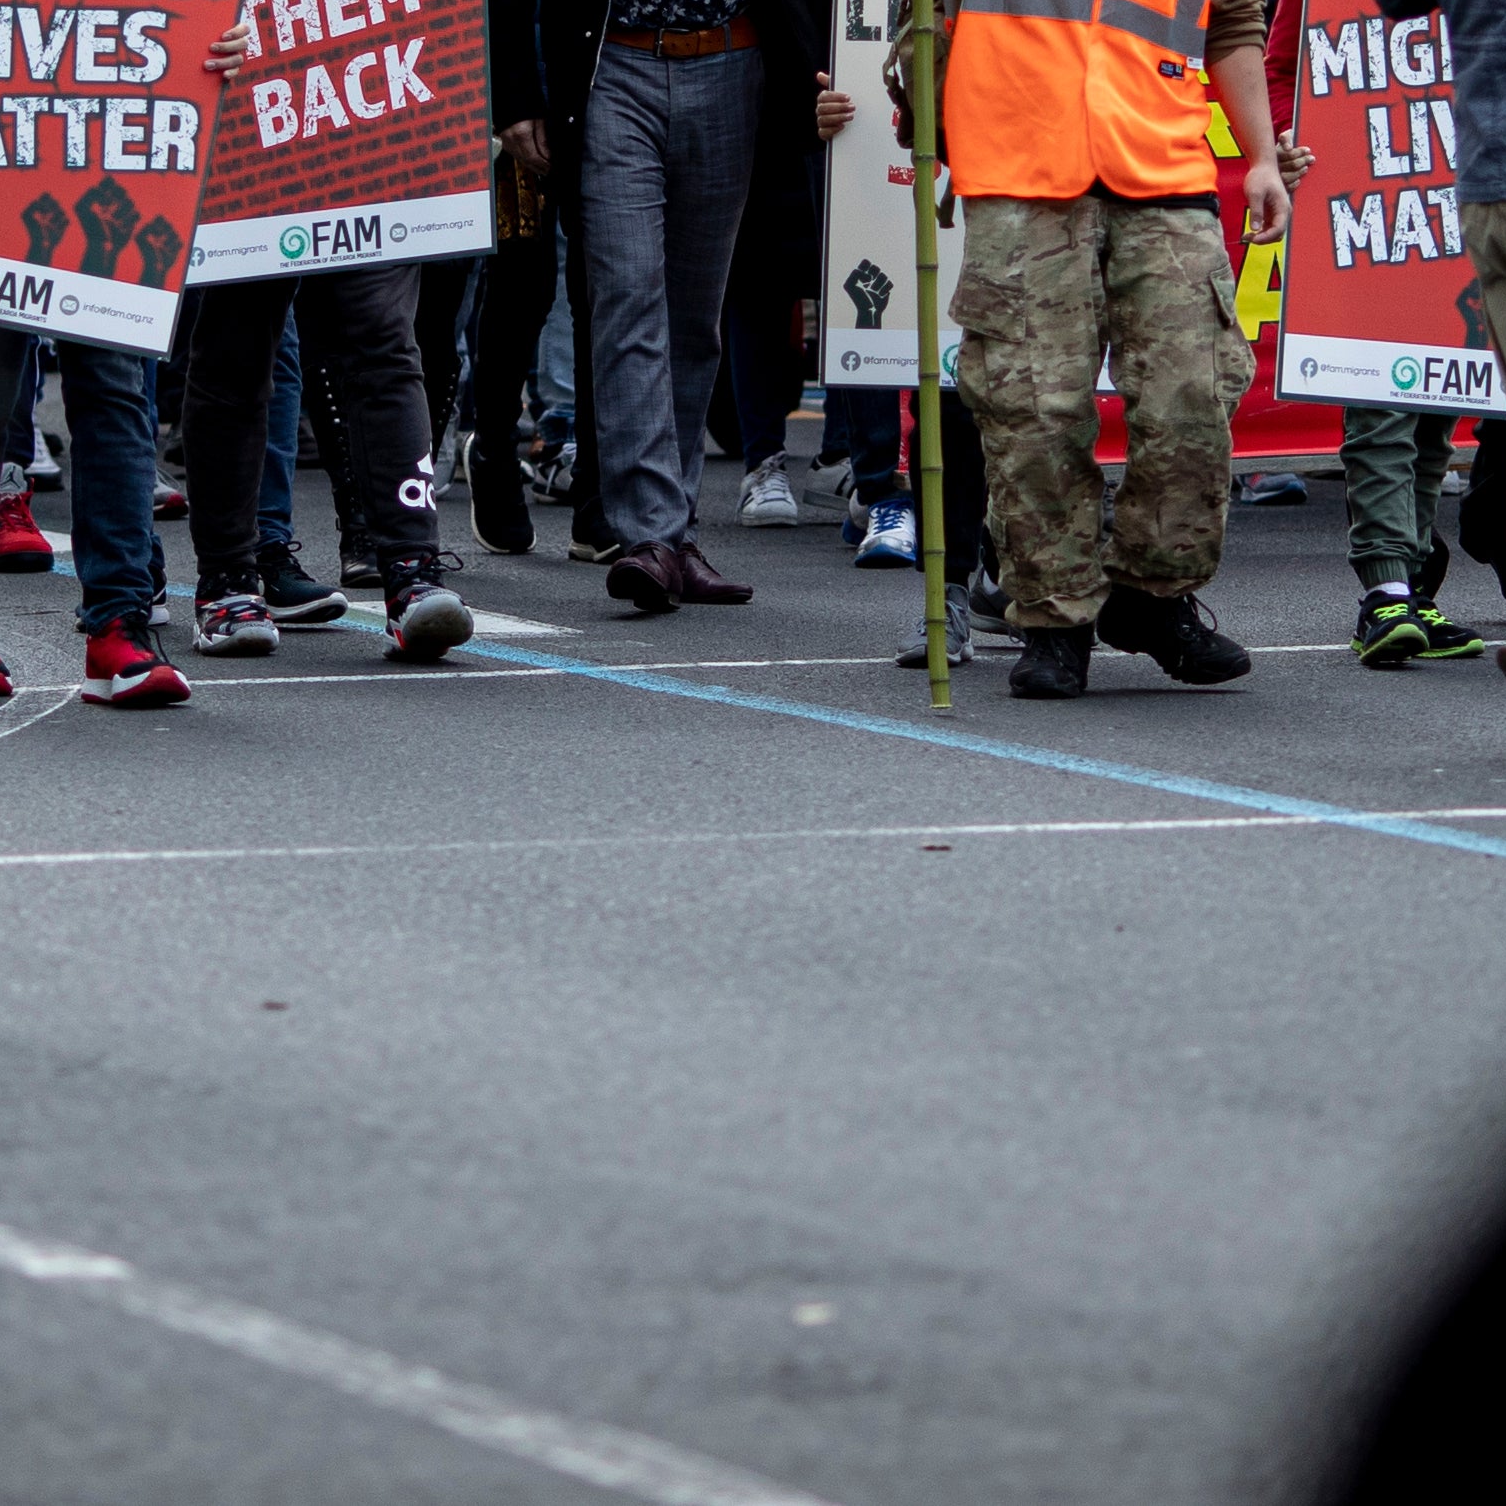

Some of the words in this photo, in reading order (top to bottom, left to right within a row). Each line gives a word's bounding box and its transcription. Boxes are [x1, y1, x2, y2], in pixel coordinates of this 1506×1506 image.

[252, 36, 436, 148] BACK
[207, 243, 268, 260] @fam.migrants
[312, 214, 383, 257] FAM
[410, 218, 474, 236] info@fam.org.nz
[1330, 187, 1462, 269] MAT
[82, 303, 154, 325] info@fam.org.nz
[1320, 363, 1381, 377] @fam.migrants
[1423, 357, 1493, 397] FAM
